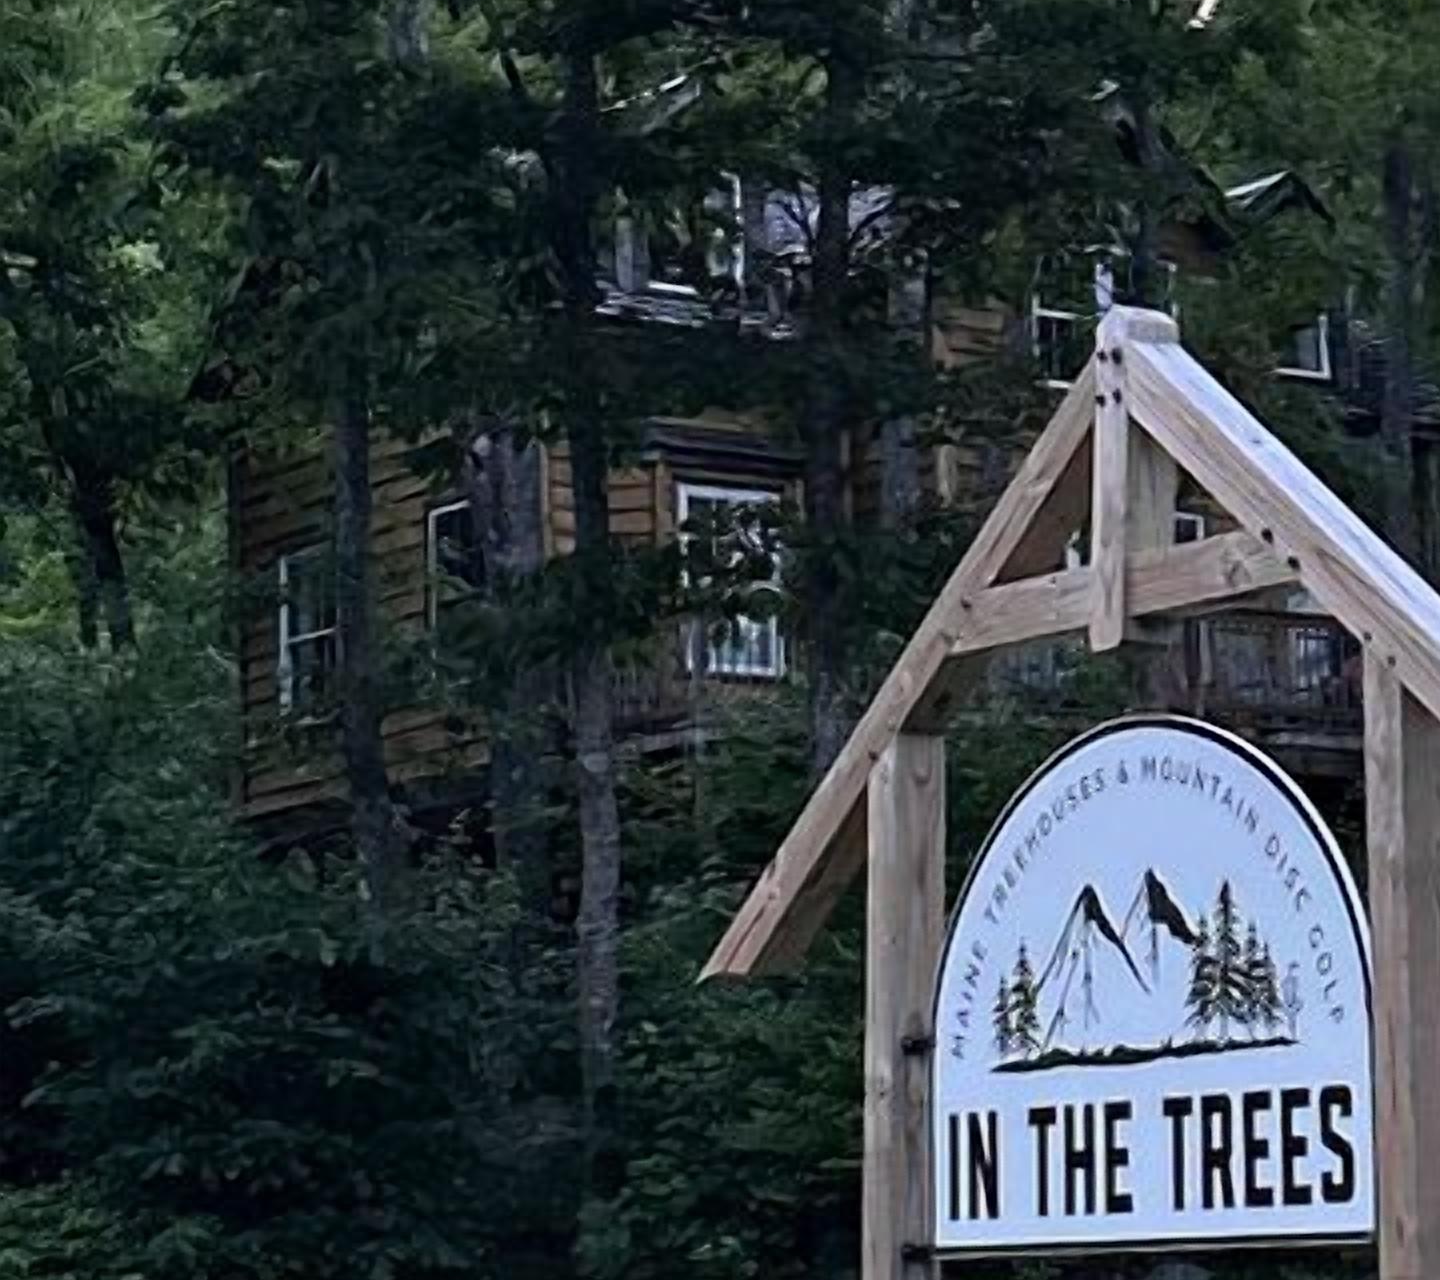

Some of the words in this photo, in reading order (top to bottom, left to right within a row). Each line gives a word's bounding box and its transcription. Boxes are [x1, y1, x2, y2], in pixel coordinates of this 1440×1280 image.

[951, 940, 988, 1058] MAINE
[984, 768, 1106, 923] TREEHOUSES
[1140, 755, 1259, 834] MOUNTAIN
[1308, 923, 1345, 1024] GOLF
[949, 1111, 999, 1221] IN
[1028, 1101, 1134, 1217] THE
[1163, 1085, 1356, 1211] TREES
